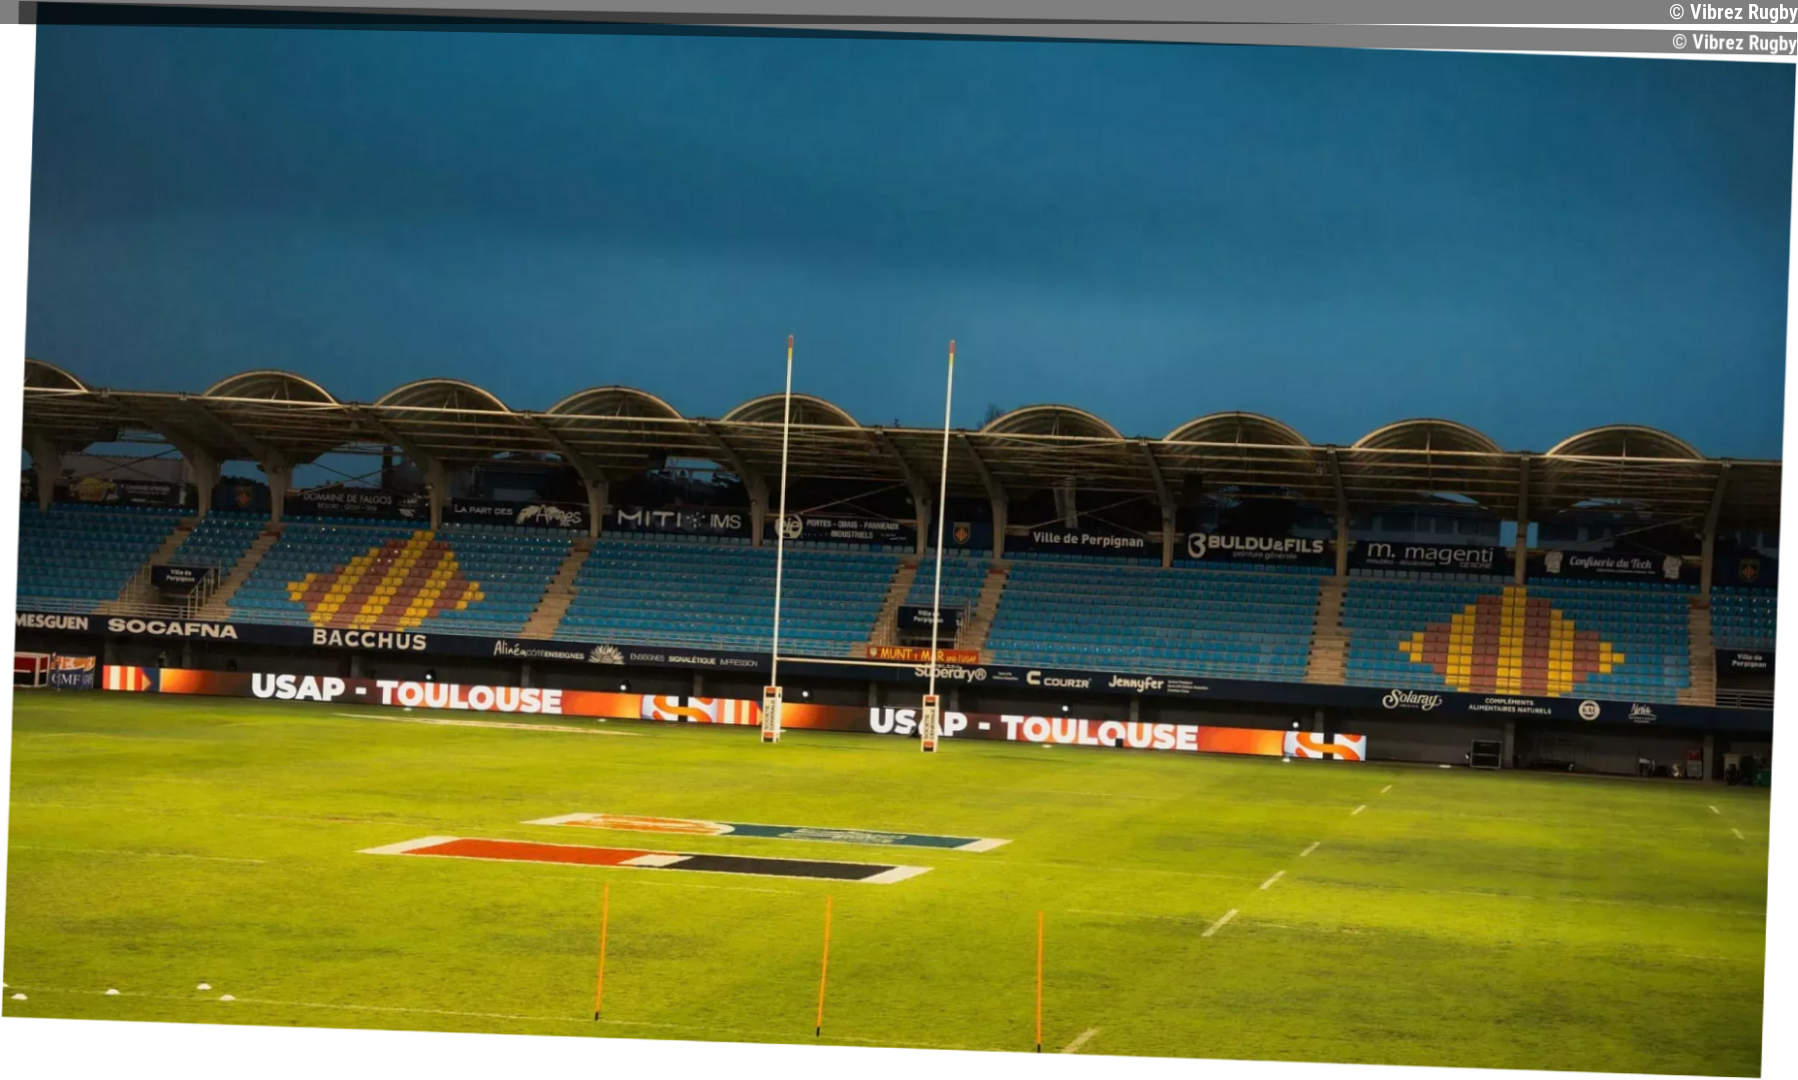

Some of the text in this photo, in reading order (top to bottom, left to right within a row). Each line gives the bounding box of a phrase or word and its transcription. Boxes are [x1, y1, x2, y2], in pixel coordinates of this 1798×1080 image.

[304, 492, 392, 505] DOMAINE DE FALGOS
[469, 506, 493, 515] PART
[494, 508, 513, 516] DES
[710, 514, 742, 529] IMS
[806, 519, 832, 528] PORTES
[838, 520, 858, 529] QUAIS
[864, 521, 900, 531] PANNEAUX
[830, 530, 874, 540] INDUSTRIELS
[1033, 531, 1144, 548] Ville de Perpignan
[1367, 542, 1494, 565] m. magenti
[1569, 555, 1653, 570] Confiserie du Tech
[166, 574, 196, 583] Perpignan
[170, 568, 183, 576] Ville
[14, 613, 88, 631] MESGUEN
[108, 618, 238, 639] SOCAFNA
[312, 628, 427, 651] BACCHUS
[493, 639, 527, 657] Alinéa
[880, 647, 912, 659] MUNT
[921, 648, 944, 661] MR
[1731, 659, 1767, 668] Perpignan
[1737, 653, 1753, 661] Ville
[1108, 674, 1164, 693] Jennyfer
[252, 673, 345, 701] USAP
[376, 680, 563, 714] TOULOUSE
[1382, 689, 1443, 711] Solaray
[1468, 703, 1552, 715] ALIMENTAIRES NATURELS
[1484, 696, 1534, 707] COMPLÉMENTS
[1001, 714, 1199, 751] TOULOUSE
